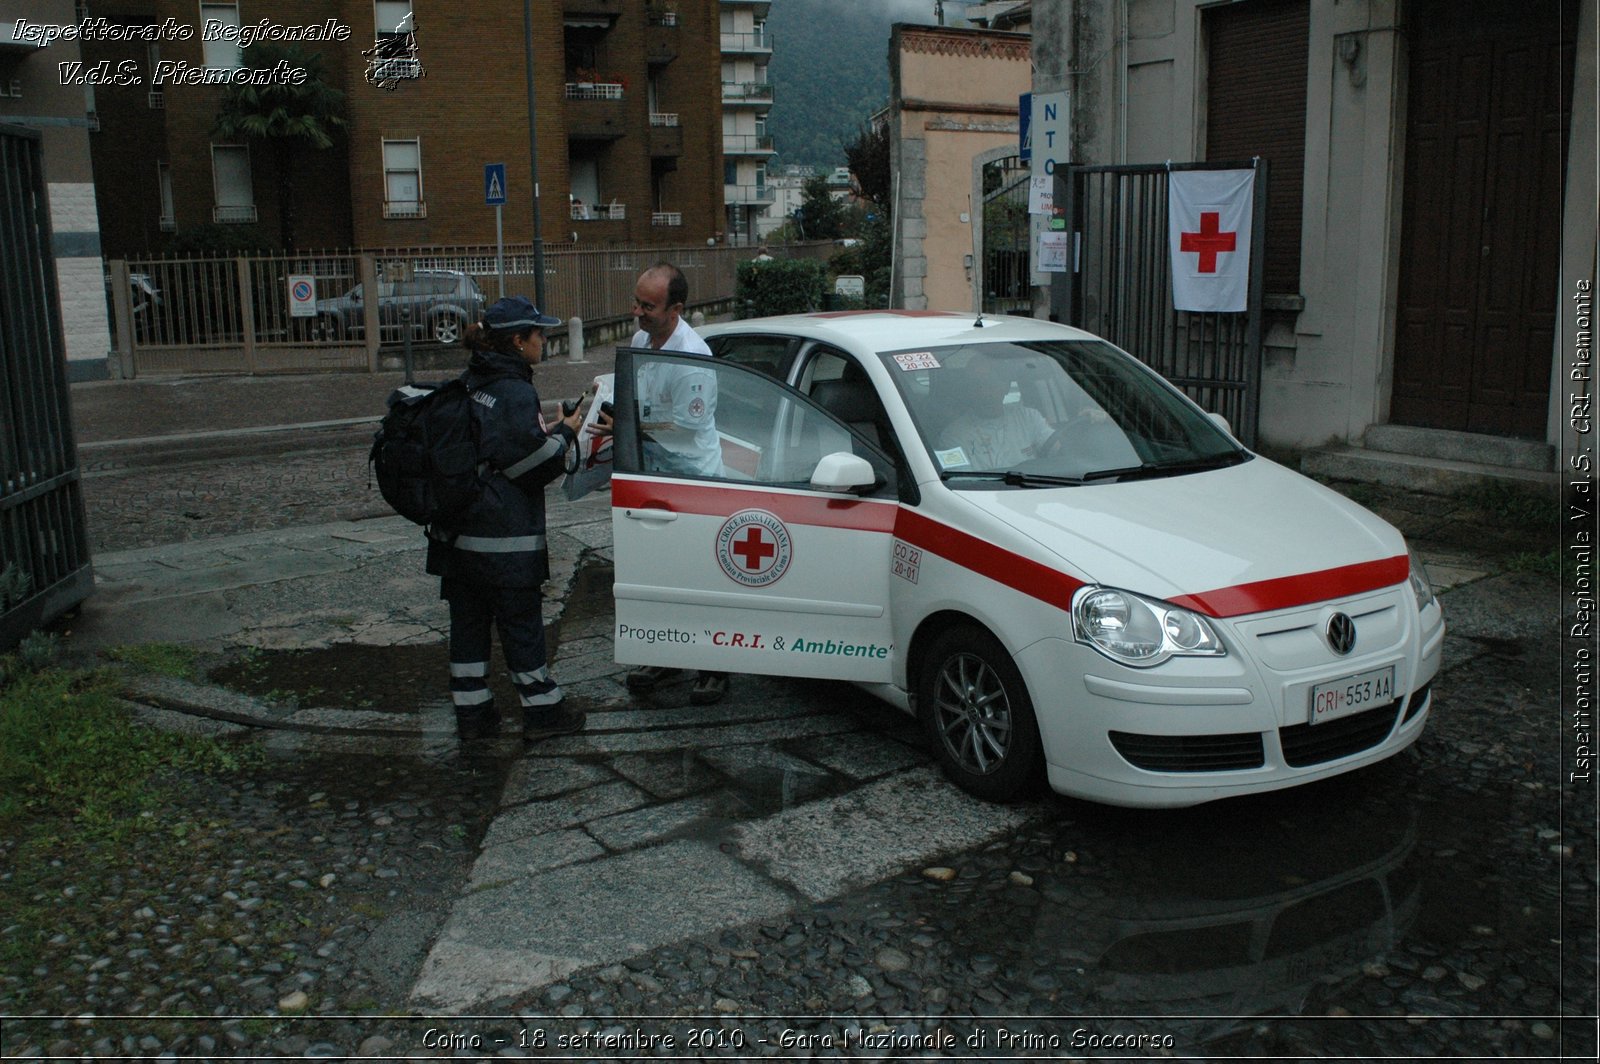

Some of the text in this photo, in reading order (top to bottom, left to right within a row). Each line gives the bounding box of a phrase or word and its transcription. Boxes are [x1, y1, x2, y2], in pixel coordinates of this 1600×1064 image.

[720, 513, 788, 549] CROCE ROSSA ITALIANA
[720, 549, 737, 575] Comitato
[736, 573, 771, 585] Provinciale
[775, 555, 788, 573] Como
[895, 544, 919, 565] CO 22
[619, 624, 697, 643] Progetto:
[772, 636, 786, 651] &
[1346, 681, 1371, 706] 553
[1375, 677, 1390, 699] AA
